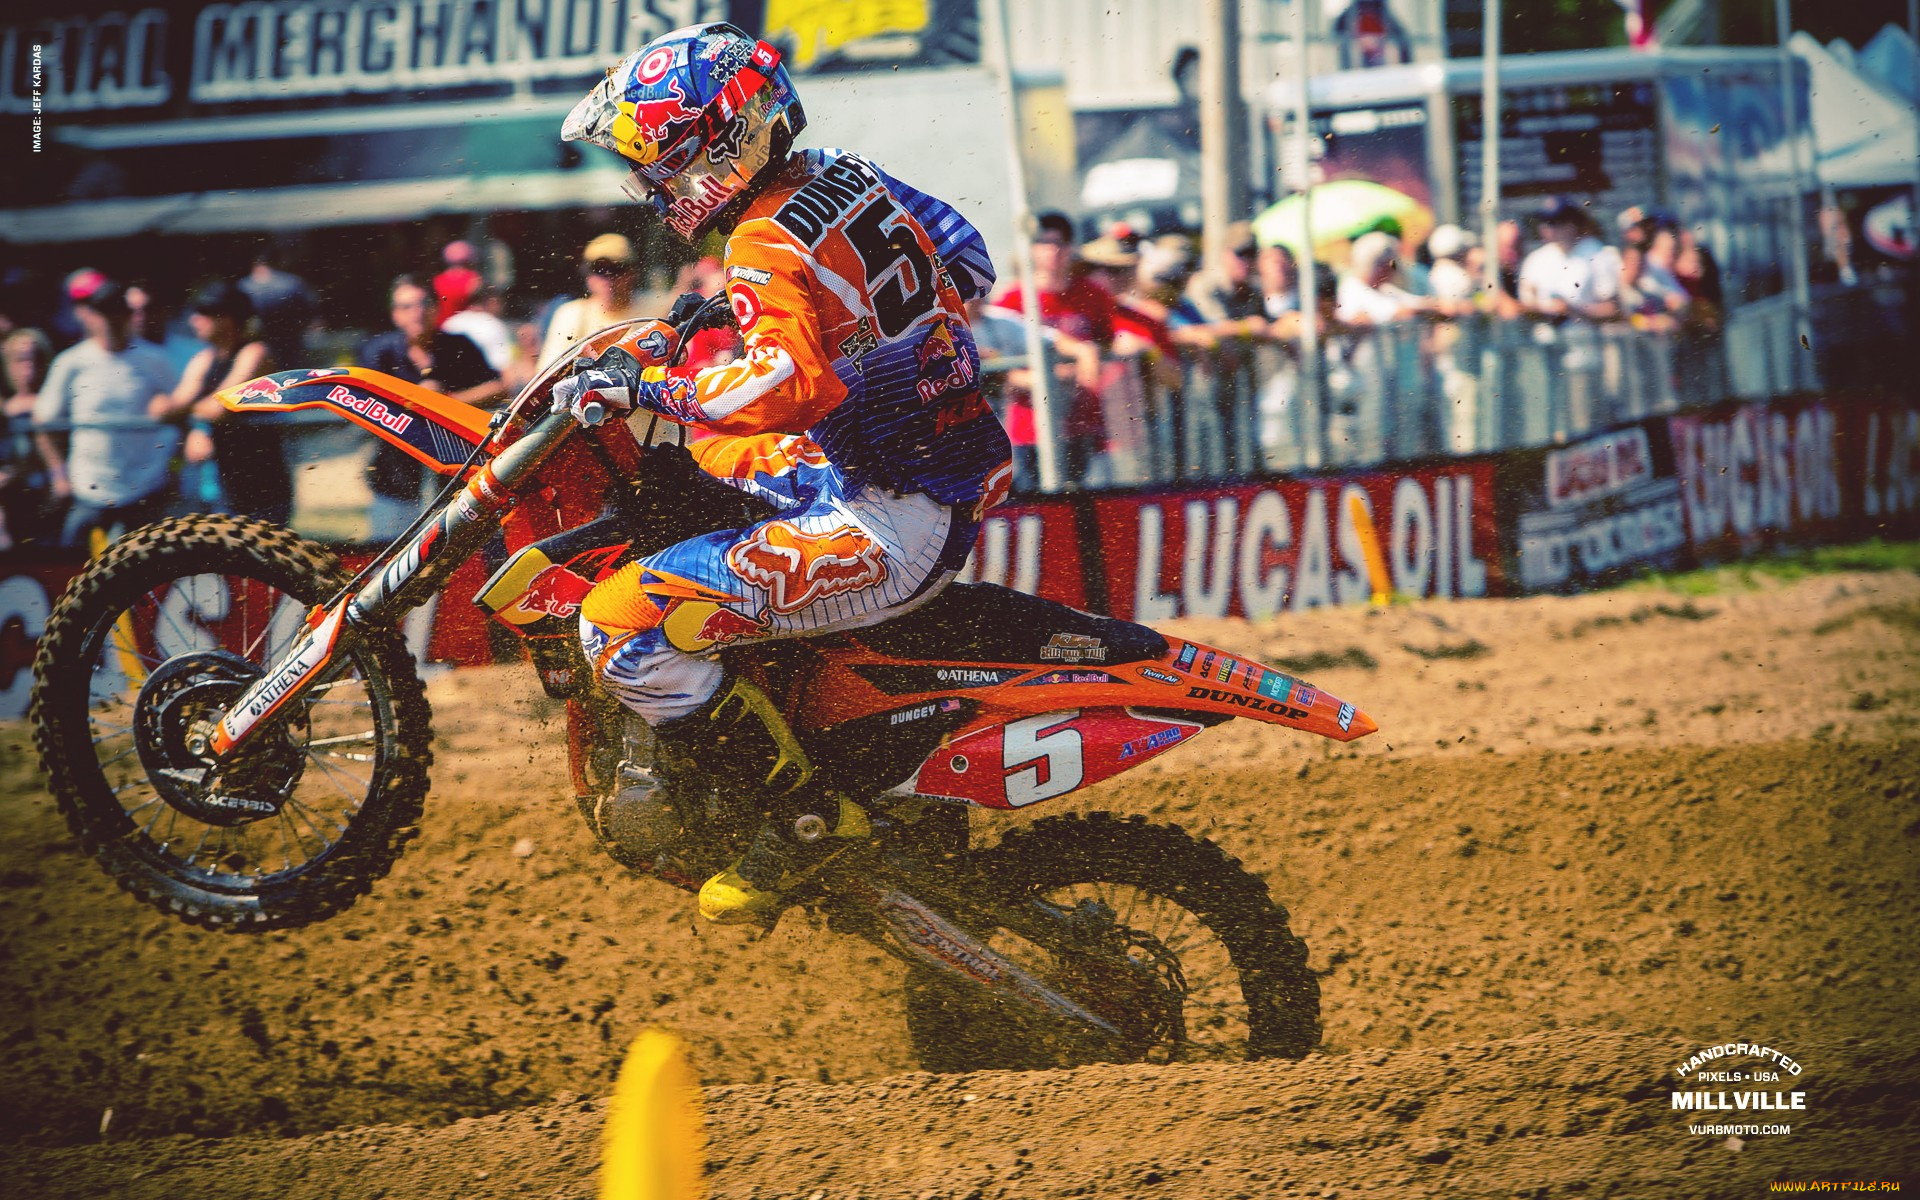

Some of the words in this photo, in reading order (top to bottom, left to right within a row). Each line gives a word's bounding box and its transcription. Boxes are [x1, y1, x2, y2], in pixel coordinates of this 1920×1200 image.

[757, 48, 773, 64] 5
[675, 172, 737, 224] Bull
[773, 153, 881, 252] DUNGE
[841, 190, 941, 341] 5
[326, 385, 375, 414] Red
[365, 401, 413, 435] Bull
[1134, 483, 1372, 622] LUCAS
[1391, 474, 1487, 598] OIL
[261, 660, 310, 710] ATHENA
[948, 669, 999, 682] ATHENA
[1073, 674, 1091, 682] Red
[1143, 668, 1166, 680] Twin
[1164, 674, 1180, 683] Air
[890, 705, 936, 725] DUNGEY
[1186, 687, 1309, 720] DUNLOP
[1157, 726, 1180, 740] PRO
[1002, 709, 1083, 808] 5
